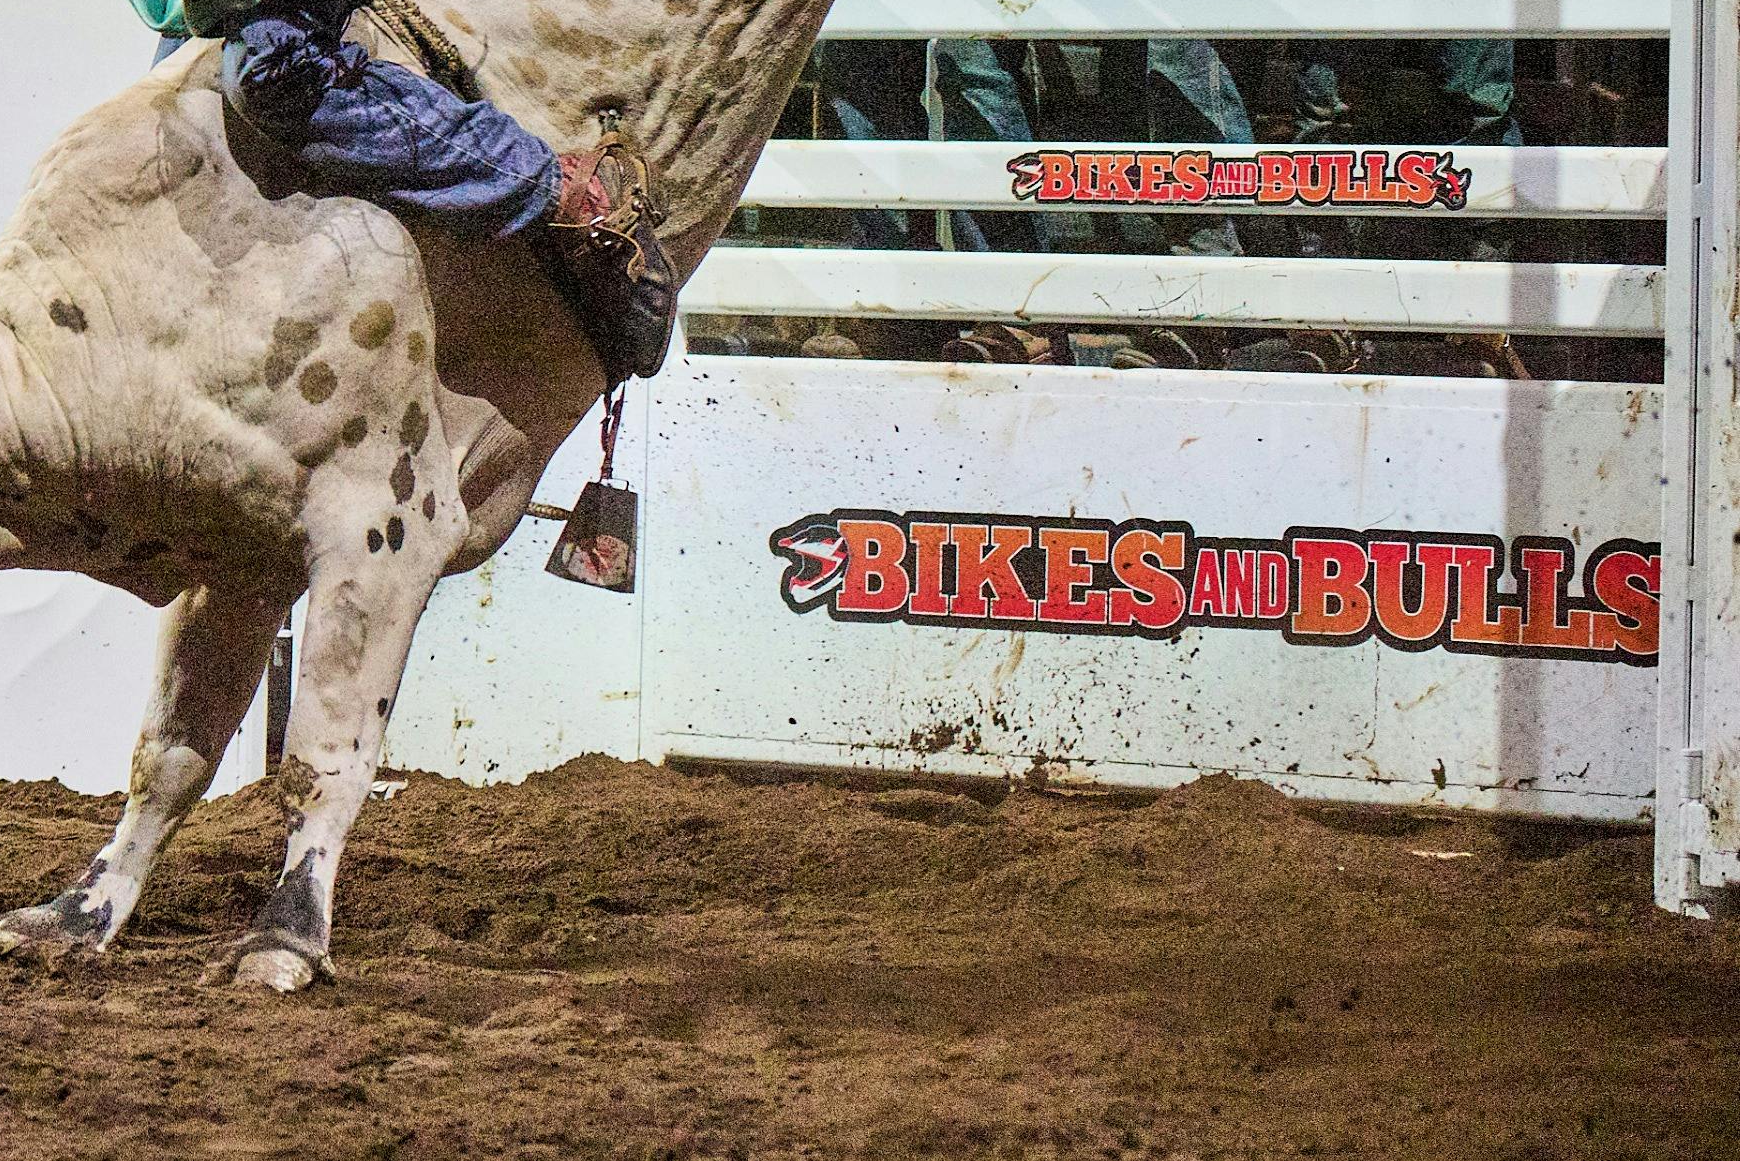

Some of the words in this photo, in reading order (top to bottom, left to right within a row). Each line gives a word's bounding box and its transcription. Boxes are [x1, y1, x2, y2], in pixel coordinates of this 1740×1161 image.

[1037, 151, 1210, 203] BIKES
[1209, 161, 1258, 197] AND
[1257, 153, 1438, 204] BULLS
[835, 519, 1188, 630] BIKES
[1188, 547, 1288, 619] AND
[1290, 537, 1662, 655] BULLS
